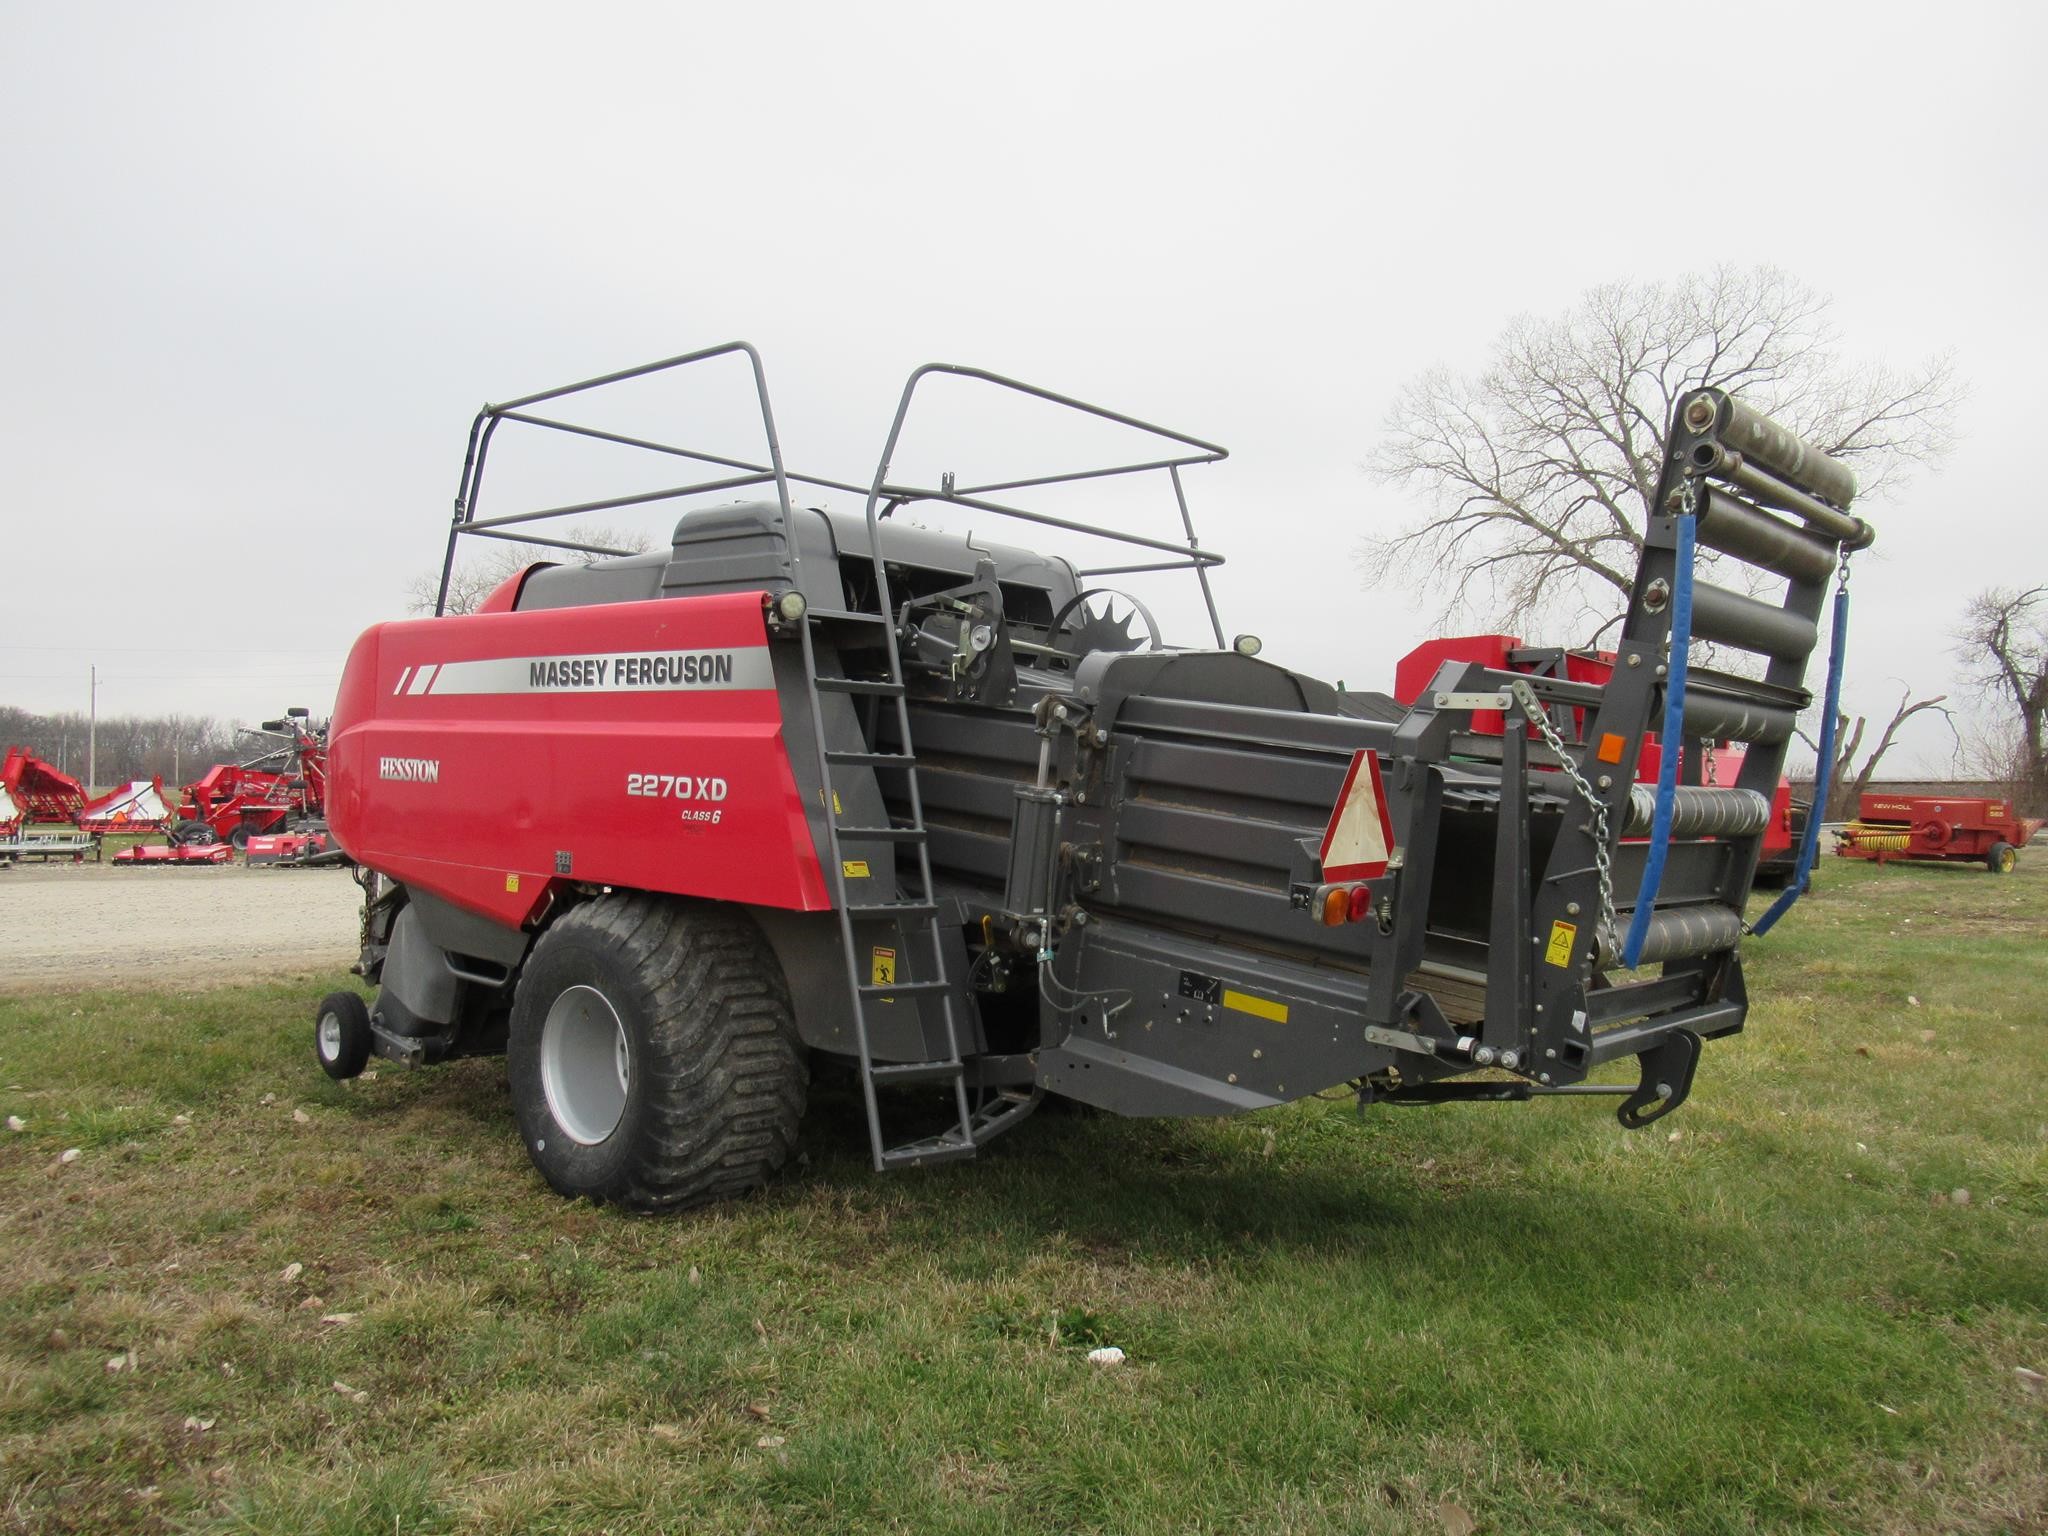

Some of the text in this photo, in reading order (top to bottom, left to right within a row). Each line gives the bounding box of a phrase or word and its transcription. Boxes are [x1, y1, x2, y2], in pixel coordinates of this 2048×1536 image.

[530, 654, 733, 687] MASSEY FERGUSON
[380, 756, 440, 784] HESSTON
[681, 809, 722, 825] CLASS 6
[1872, 802, 1891, 810] NEW
